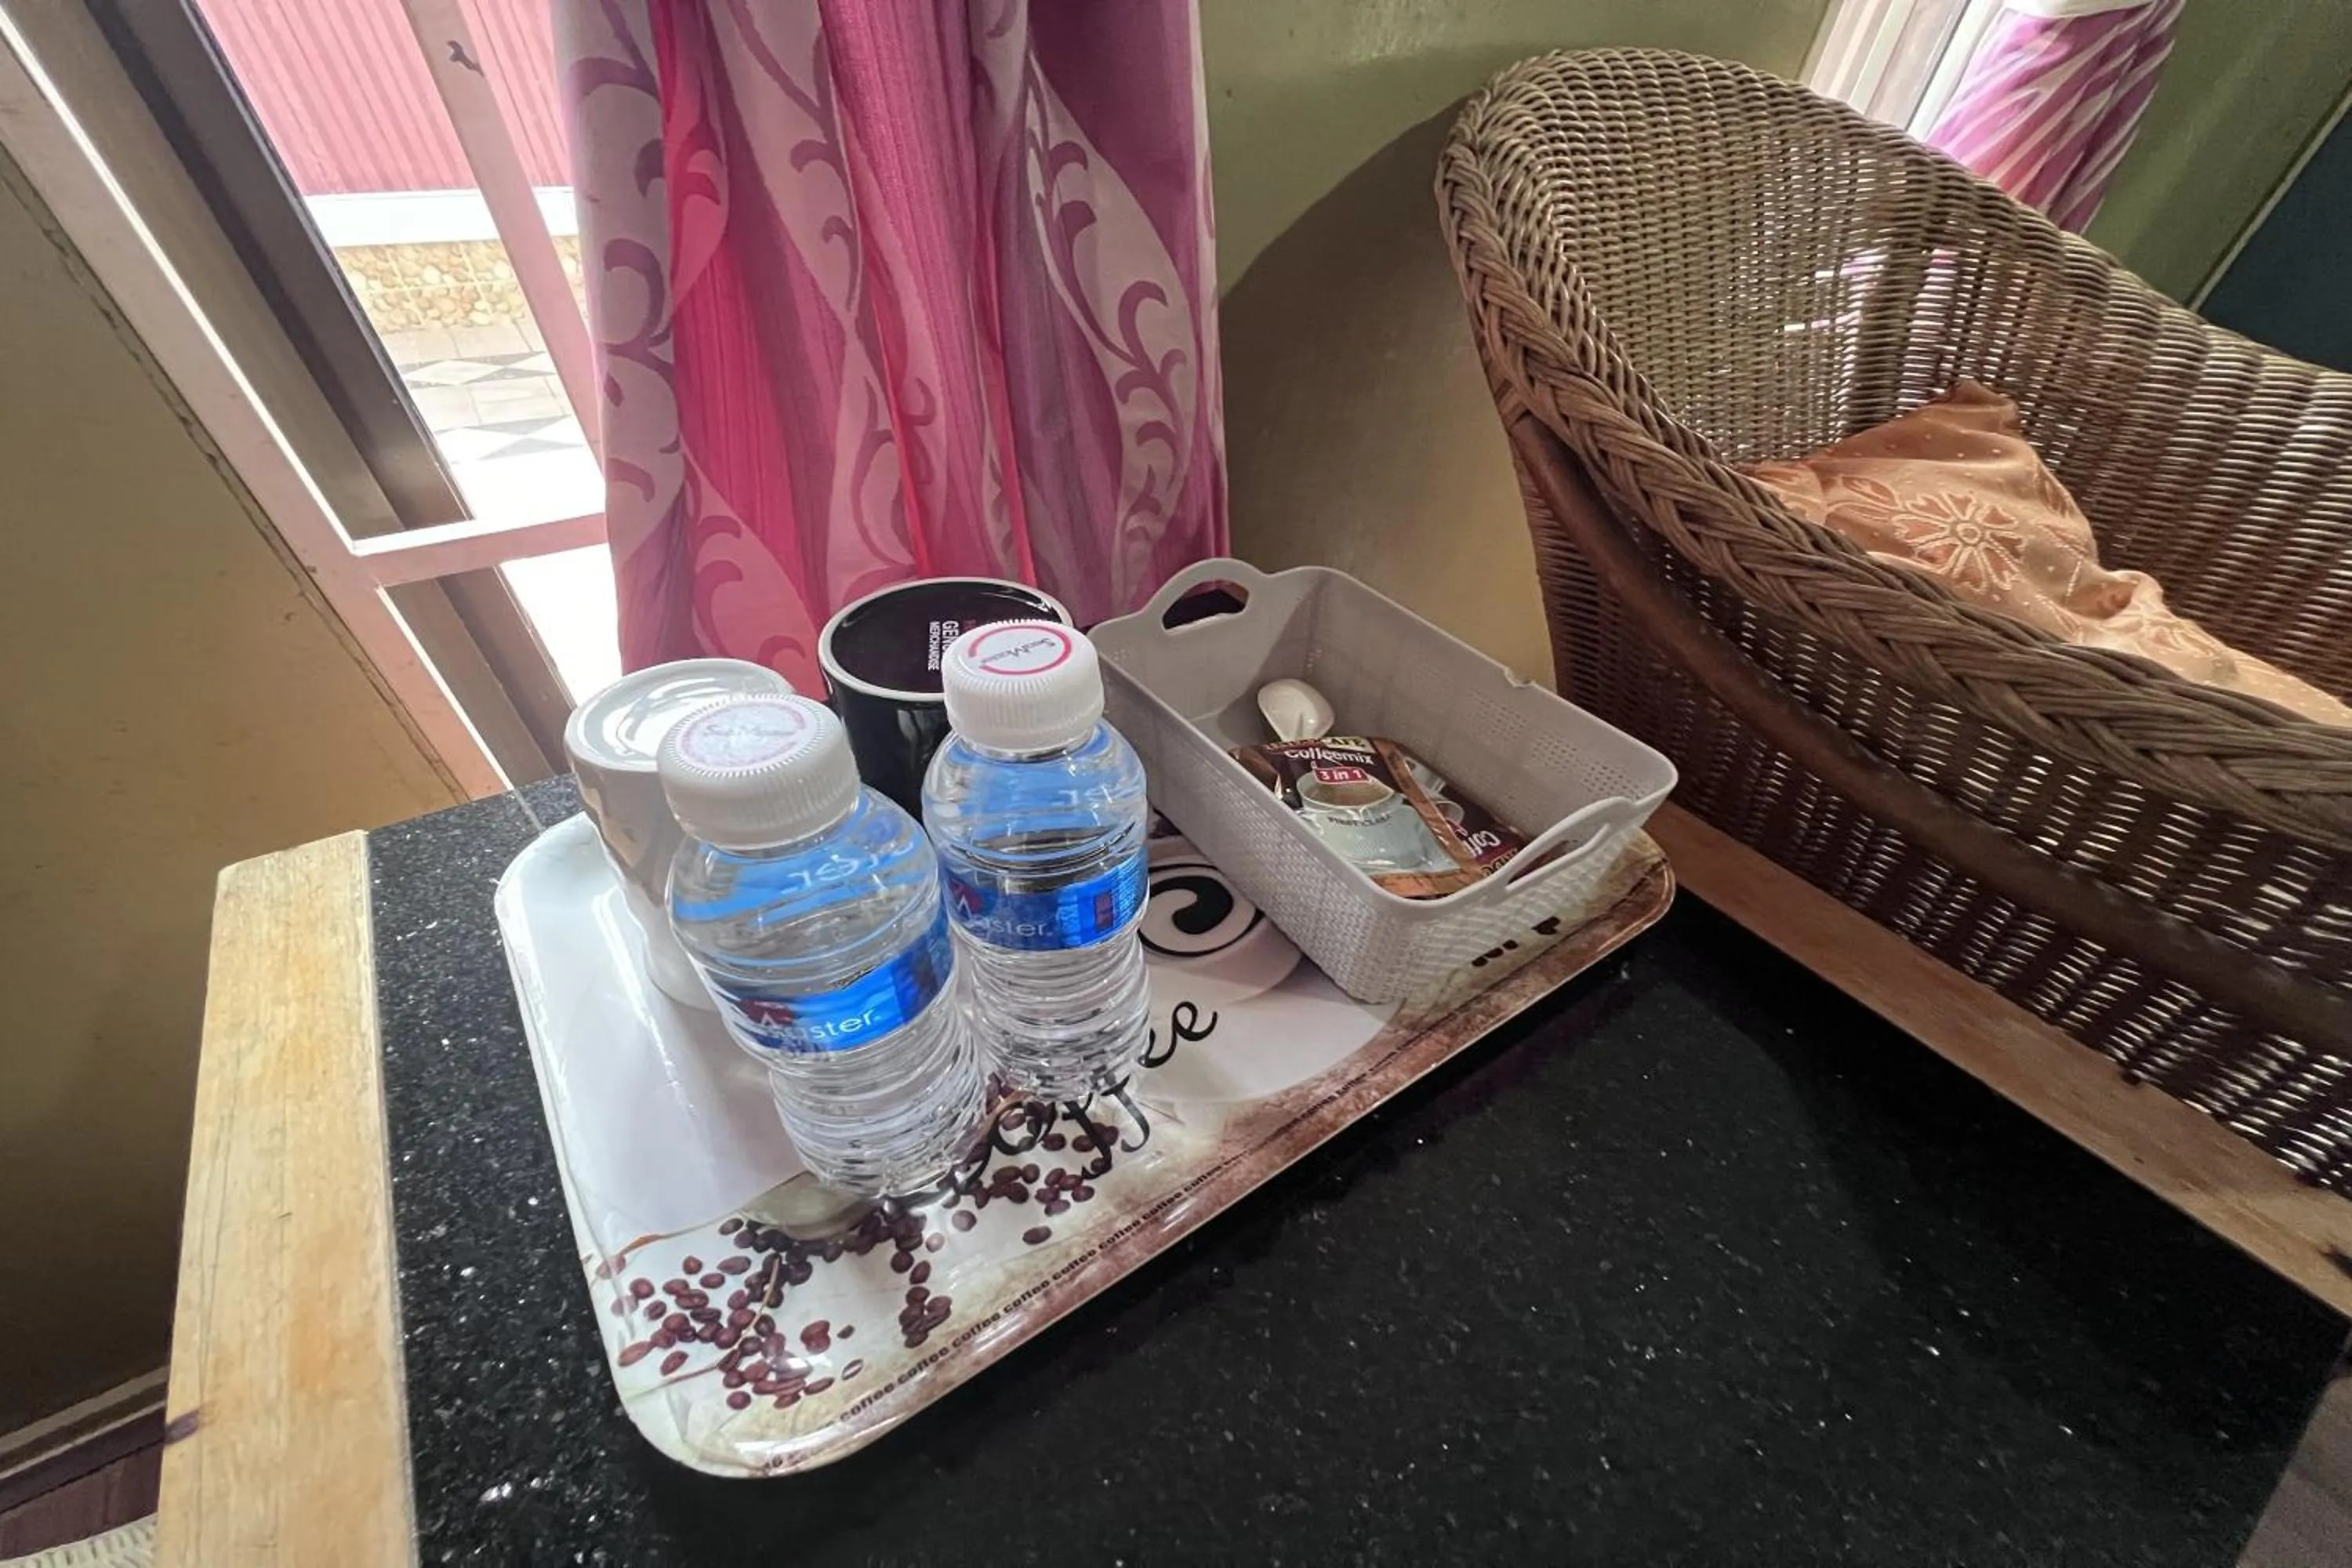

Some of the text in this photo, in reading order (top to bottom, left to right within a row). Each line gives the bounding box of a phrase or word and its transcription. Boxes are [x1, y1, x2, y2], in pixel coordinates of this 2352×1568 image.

[1319, 769, 1363, 780] 3 in 1
[897, 1346, 949, 1385] coffee
[951, 1312, 1001, 1349] coffee
[1003, 1279, 1051, 1314] coffee
[1052, 1248, 1097, 1281] coffee
